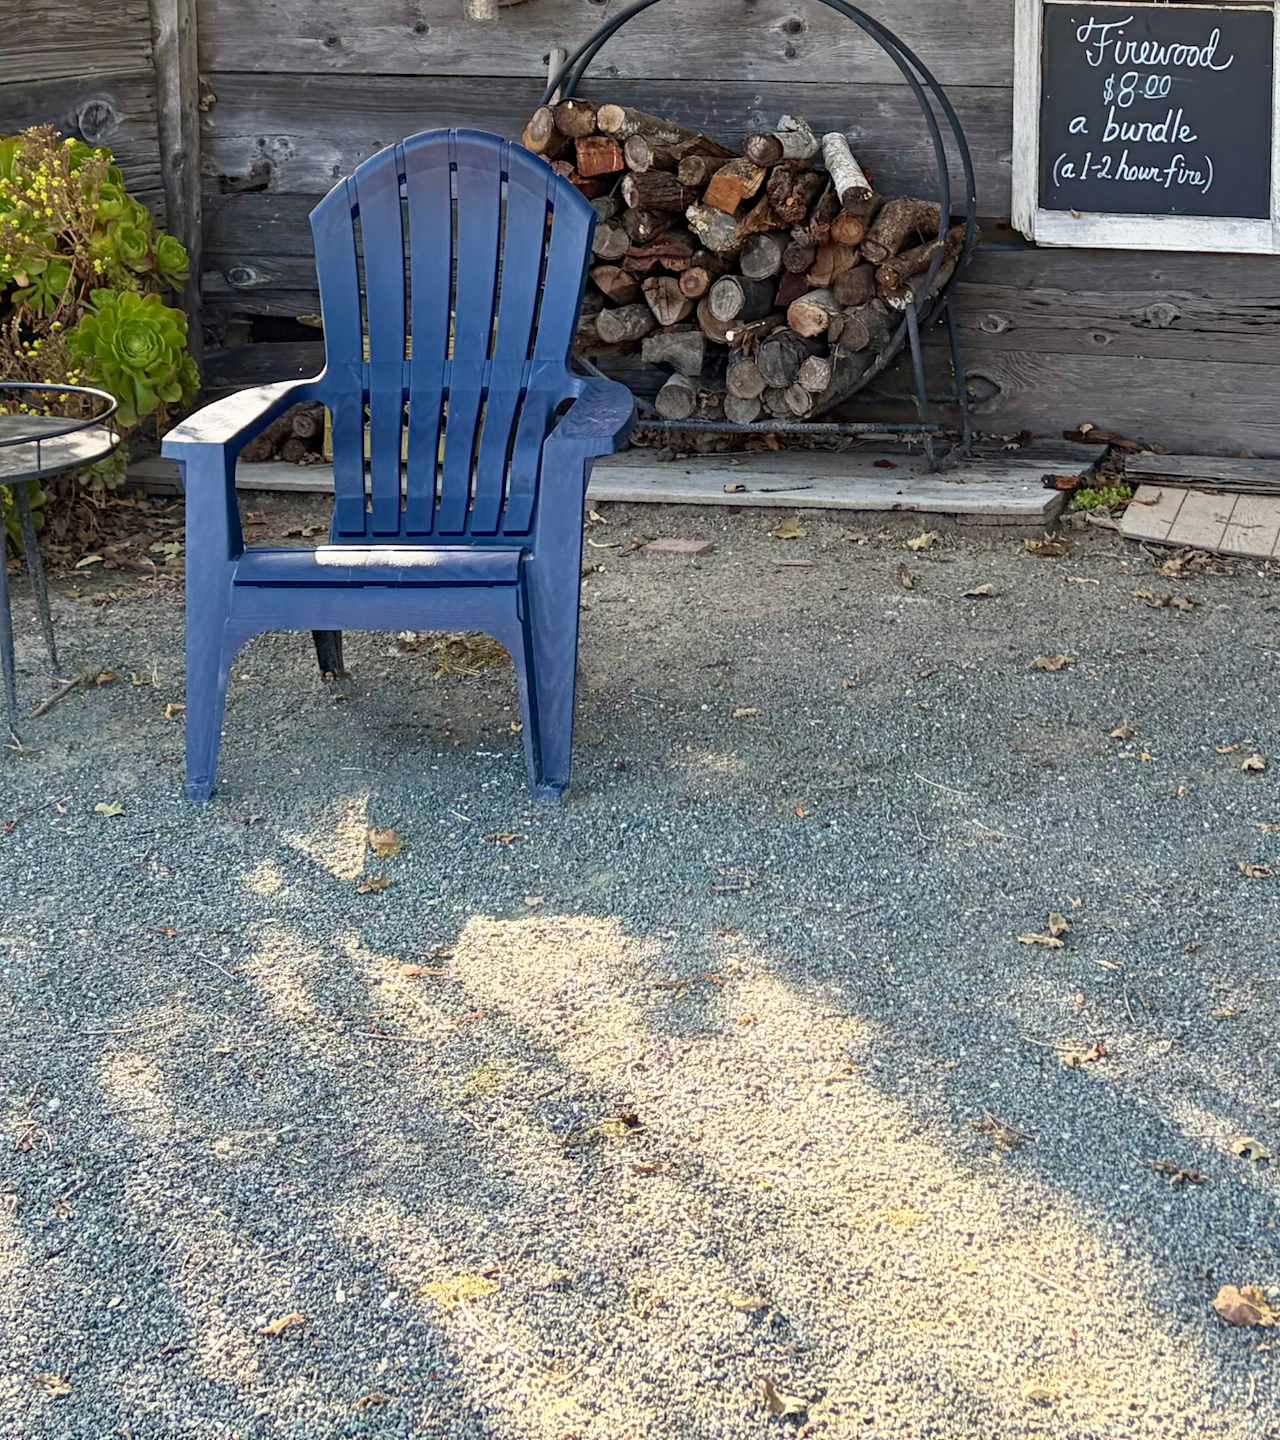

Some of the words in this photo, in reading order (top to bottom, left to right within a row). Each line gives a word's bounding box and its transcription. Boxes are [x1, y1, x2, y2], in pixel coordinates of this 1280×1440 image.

[1077, 16, 1233, 70] Firewood
[1103, 72, 1172, 107] $8.00
[1069, 116, 1088, 134] a
[1102, 106, 1197, 143] bundle
[1053, 153, 1076, 187] (a
[1080, 152, 1112, 180] 1-2
[1115, 149, 1163, 181] hour
[1163, 154, 1214, 194] fire)
